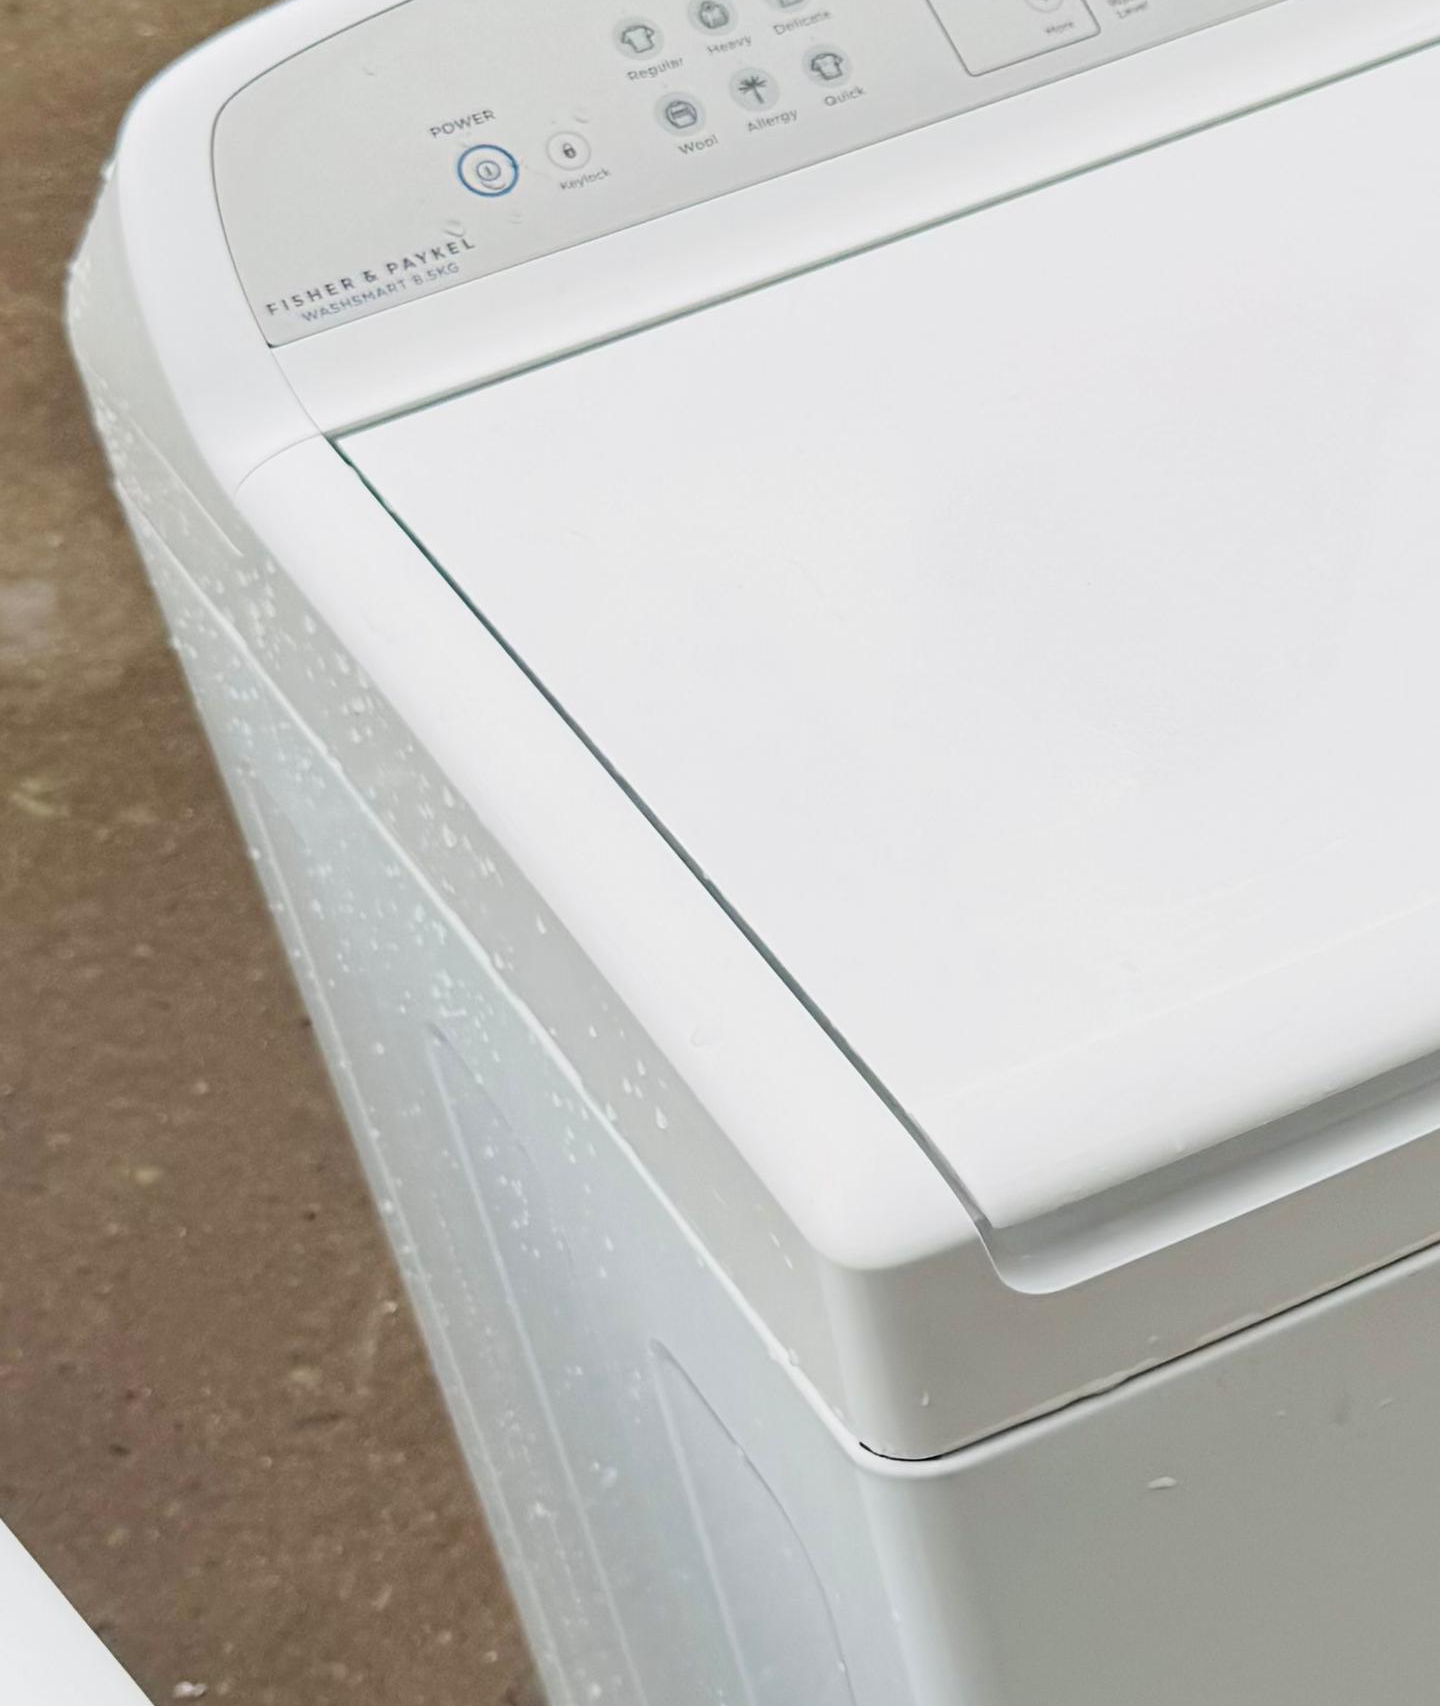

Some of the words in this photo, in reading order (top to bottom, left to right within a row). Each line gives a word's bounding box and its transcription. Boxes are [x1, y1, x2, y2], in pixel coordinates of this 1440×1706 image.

[773, 9, 832, 36] Delicate
[706, 35, 752, 56] Heavy
[627, 56, 684, 82] Regular
[823, 85, 866, 107] Quick
[429, 108, 497, 139] POWER
[747, 108, 799, 133] Allergy
[678, 134, 719, 156] Wool
[559, 166, 612, 191] Keylock
[266, 278, 356, 316] FISHER
[363, 269, 379, 284] &
[386, 237, 476, 275] PAYKEL
[301, 278, 408, 322] WASHSMART
[413, 261, 461, 285] 8.5KG
